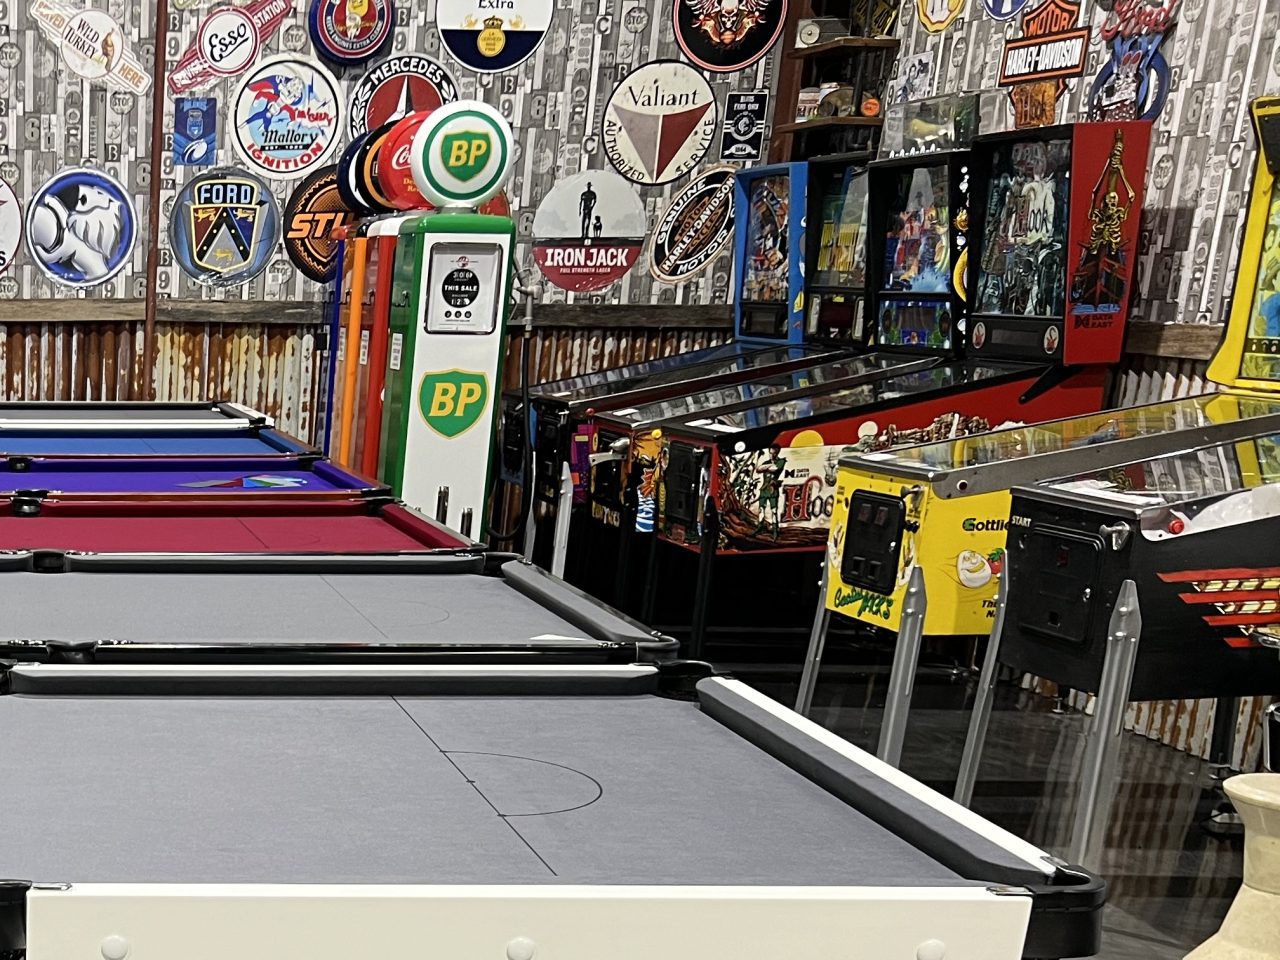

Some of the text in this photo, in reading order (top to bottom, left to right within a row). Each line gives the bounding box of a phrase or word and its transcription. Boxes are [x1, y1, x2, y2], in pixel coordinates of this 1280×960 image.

[253, 0, 287, 28] STATION
[1028, 12, 1070, 36] MOTOR
[63, 28, 99, 60] TURKEY
[76, 18, 100, 44] WILD
[208, 23, 248, 63] Esso
[1006, 38, 1085, 76] HARLEY-DAVIDSON
[117, 62, 145, 89] HERE
[370, 57, 444, 86] MERCEDES
[628, 84, 700, 107] Valiant
[261, 129, 318, 144] Mallory
[605, 119, 646, 182] AUTHORIZED
[674, 119, 714, 177] SERVICE
[246, 141, 324, 170] IGNITION
[449, 139, 488, 167] BP
[200, 184, 252, 204] FORD
[656, 178, 707, 245] GENUINE
[662, 177, 736, 272] HARLEY-DAVIDSON
[544, 248, 629, 267] IRON JACK
[676, 229, 729, 275] MOTOR
[460, 284, 478, 292] SALE
[428, 382, 482, 417] BP
[1011, 515, 1032, 528] START
